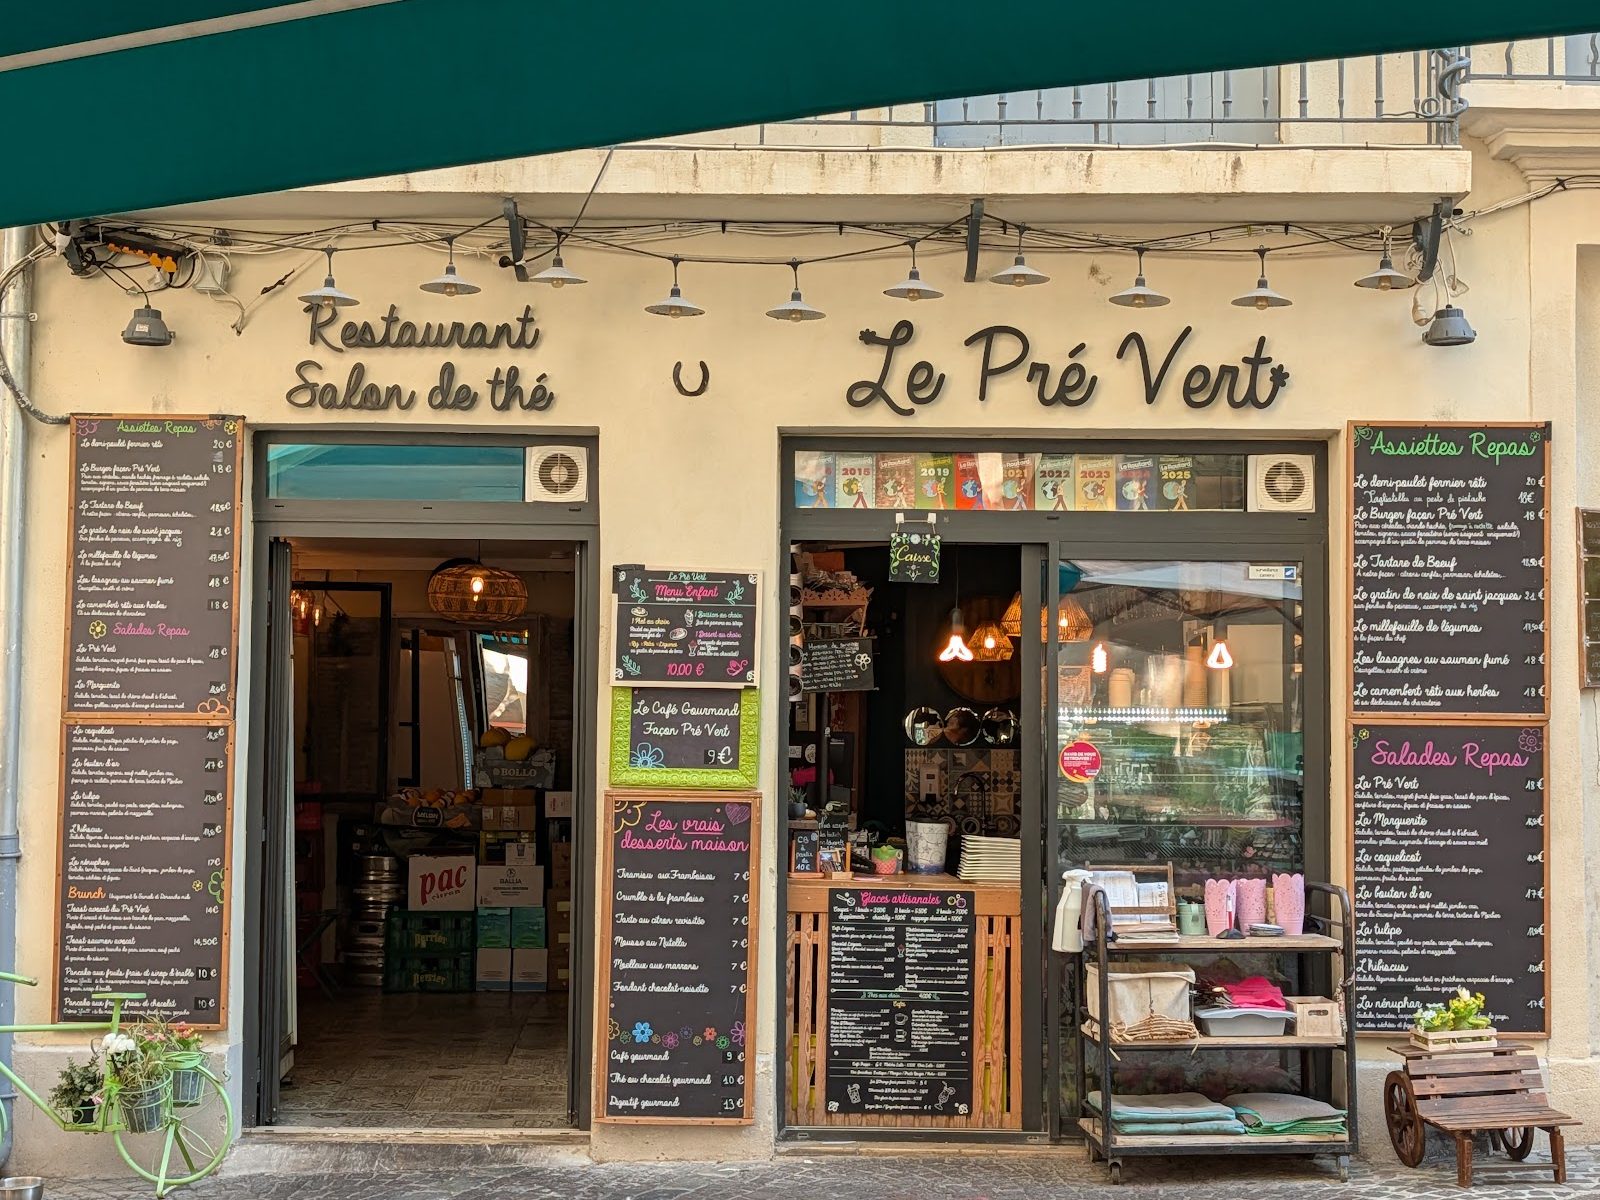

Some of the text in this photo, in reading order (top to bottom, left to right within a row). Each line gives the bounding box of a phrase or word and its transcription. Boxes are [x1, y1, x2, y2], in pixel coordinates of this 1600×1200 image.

[303, 302, 540, 352] Restaurant
[846, 319, 1289, 415] Le Pré Vert
[286, 360, 554, 411] Salon de thé
[117, 420, 197, 437] Assiettes Repas
[1370, 431, 1536, 465] Assiettes Repas
[842, 468, 870, 476] 2015
[920, 468, 949, 476] 2019
[1040, 470, 1070, 478] 2022
[1080, 470, 1110, 479] 2023
[1161, 471, 1191, 479] 2025
[1353, 474, 1368, 488] Le
[1429, 475, 1465, 491] fermier
[1468, 475, 1487, 488] rôti
[1526, 477, 1535, 486] 20
[1353, 506, 1484, 524] Le Burger façon Pré Vert
[896, 544, 932, 564] Caisse
[1353, 554, 1368, 568] Le
[1370, 554, 1411, 568] Tartare
[1412, 555, 1425, 568] de
[679, 572, 692, 581] Pré
[692, 573, 707, 581] Vert
[655, 585, 718, 600] Menu Enfant
[1353, 586, 1522, 605] Le gratin de noix de saint jacques
[113, 623, 190, 639] Salades Repas
[1353, 618, 1482, 636] Le millefeuille de légumes
[1353, 650, 1510, 670] Les lasagnes au saumon fumé
[696, 663, 705, 676] €
[633, 699, 740, 718] Le Café Gourmand
[643, 722, 730, 737] Façon Pré Vert
[1371, 740, 1529, 776] Salades Repas
[501, 767, 537, 778] BOLLO
[1355, 775, 1419, 790] La Pré Vert
[645, 810, 725, 833] Les vrais
[1355, 812, 1428, 829] La Marguerite
[621, 830, 750, 852] desserts maison
[1355, 848, 1422, 867] La coquelicot
[617, 868, 653, 880] Tiramisu
[657, 872, 670, 880] aux
[670, 870, 716, 880] Framboises
[742, 872, 750, 880] €
[68, 886, 106, 899] Brunch
[419, 865, 467, 906] pac
[1355, 885, 1432, 900] La bouton d'or
[616, 891, 704, 905] Crumble à la framboise
[860, 892, 941, 906] Glaces artisanales
[67, 903, 88, 913] Toast
[111, 905, 120, 913] du
[121, 905, 135, 913] Pré
[135, 905, 150, 913] Vert
[615, 913, 637, 924] Tarte
[651, 915, 673, 925] citron
[675, 916, 705, 925] revisitée
[1356, 922, 1402, 939] La tulipe
[65, 935, 88, 945] Toast
[115, 936, 136, 945] avocat
[614, 936, 645, 947] Mousse
[659, 937, 687, 948] Nutella
[614, 959, 648, 970] Moelleux
[613, 981, 647, 992] Fondant
[1357, 995, 1423, 1013] La nénuphar
[611, 1050, 745, 1063] Café gourmand 9 €
[610, 1073, 627, 1084] Thé
[640, 1074, 671, 1084] chocolat
[673, 1074, 711, 1087] gourmand
[722, 1077, 735, 1085] 10
[737, 1077, 744, 1085] €
[609, 1096, 639, 1109] Digestif
[641, 1097, 680, 1109] gourmand
[724, 1101, 735, 1110] 13
